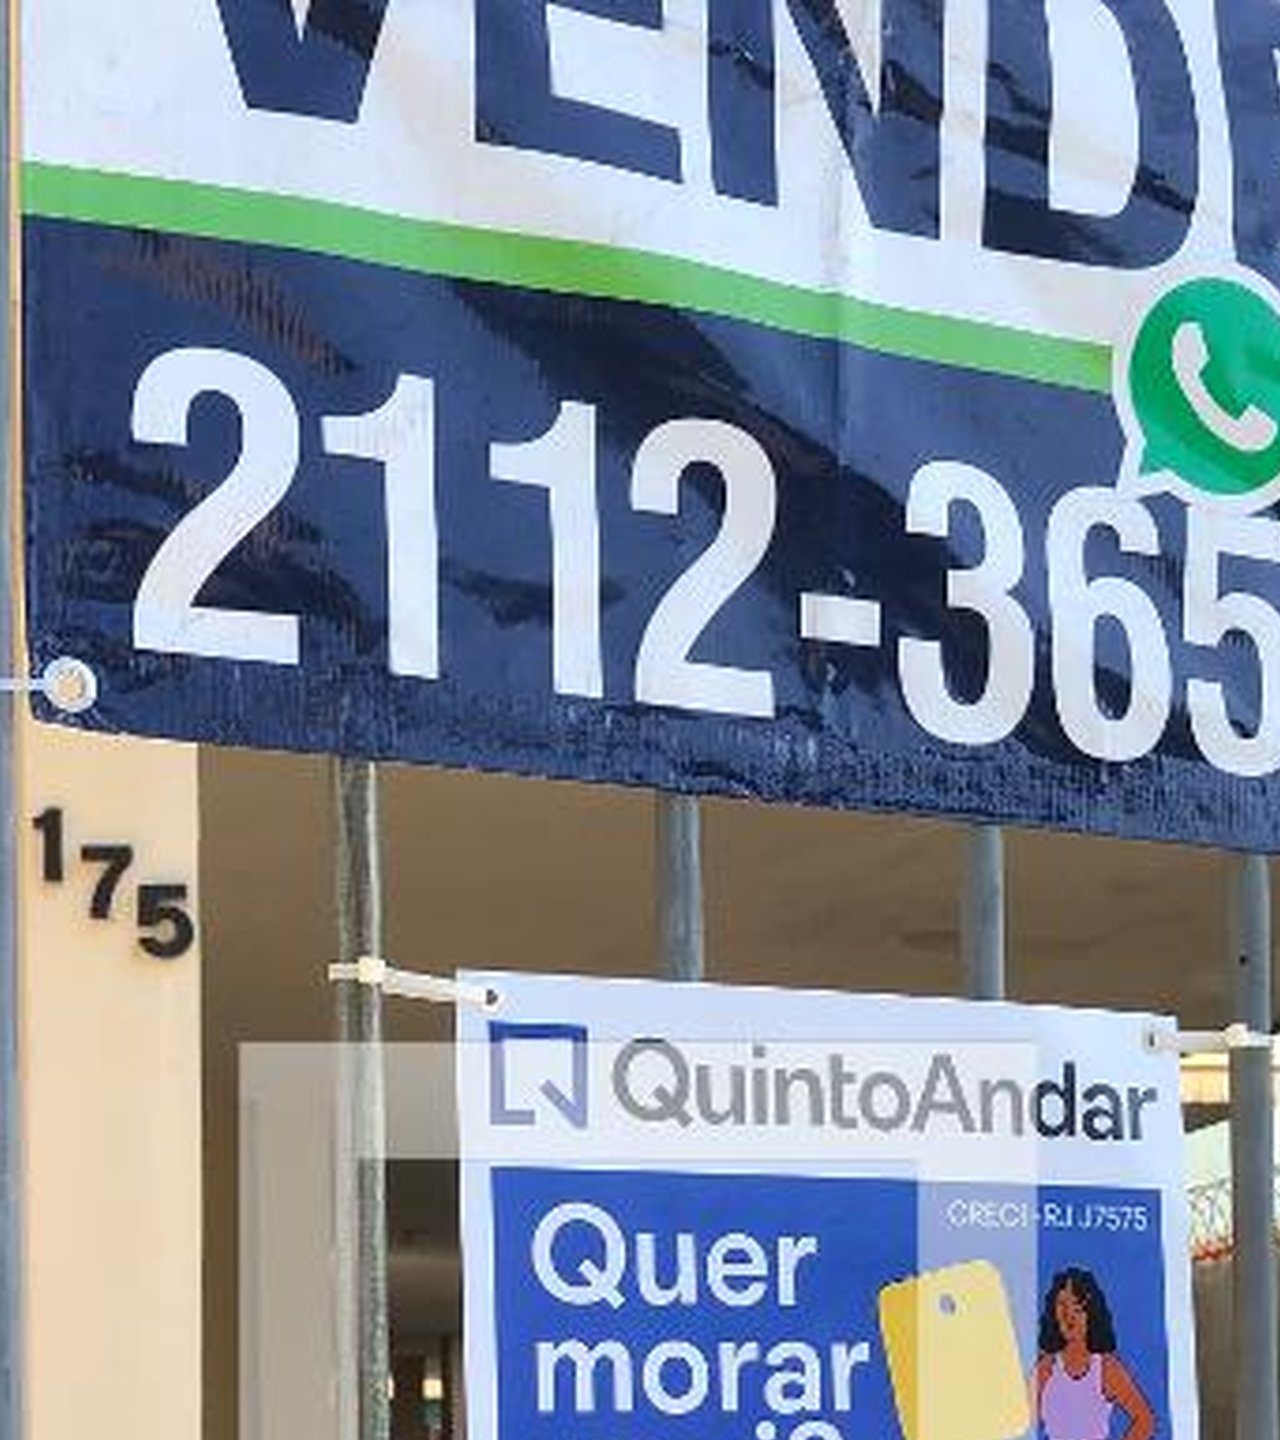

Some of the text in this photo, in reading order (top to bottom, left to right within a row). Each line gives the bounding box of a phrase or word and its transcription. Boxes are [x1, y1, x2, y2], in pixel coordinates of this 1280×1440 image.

[33, 807, 194, 960] 175
[611, 1038, 1157, 1142] QuintoAndar
[531, 1202, 819, 1310] Quer
[535, 1337, 870, 1415] morar
